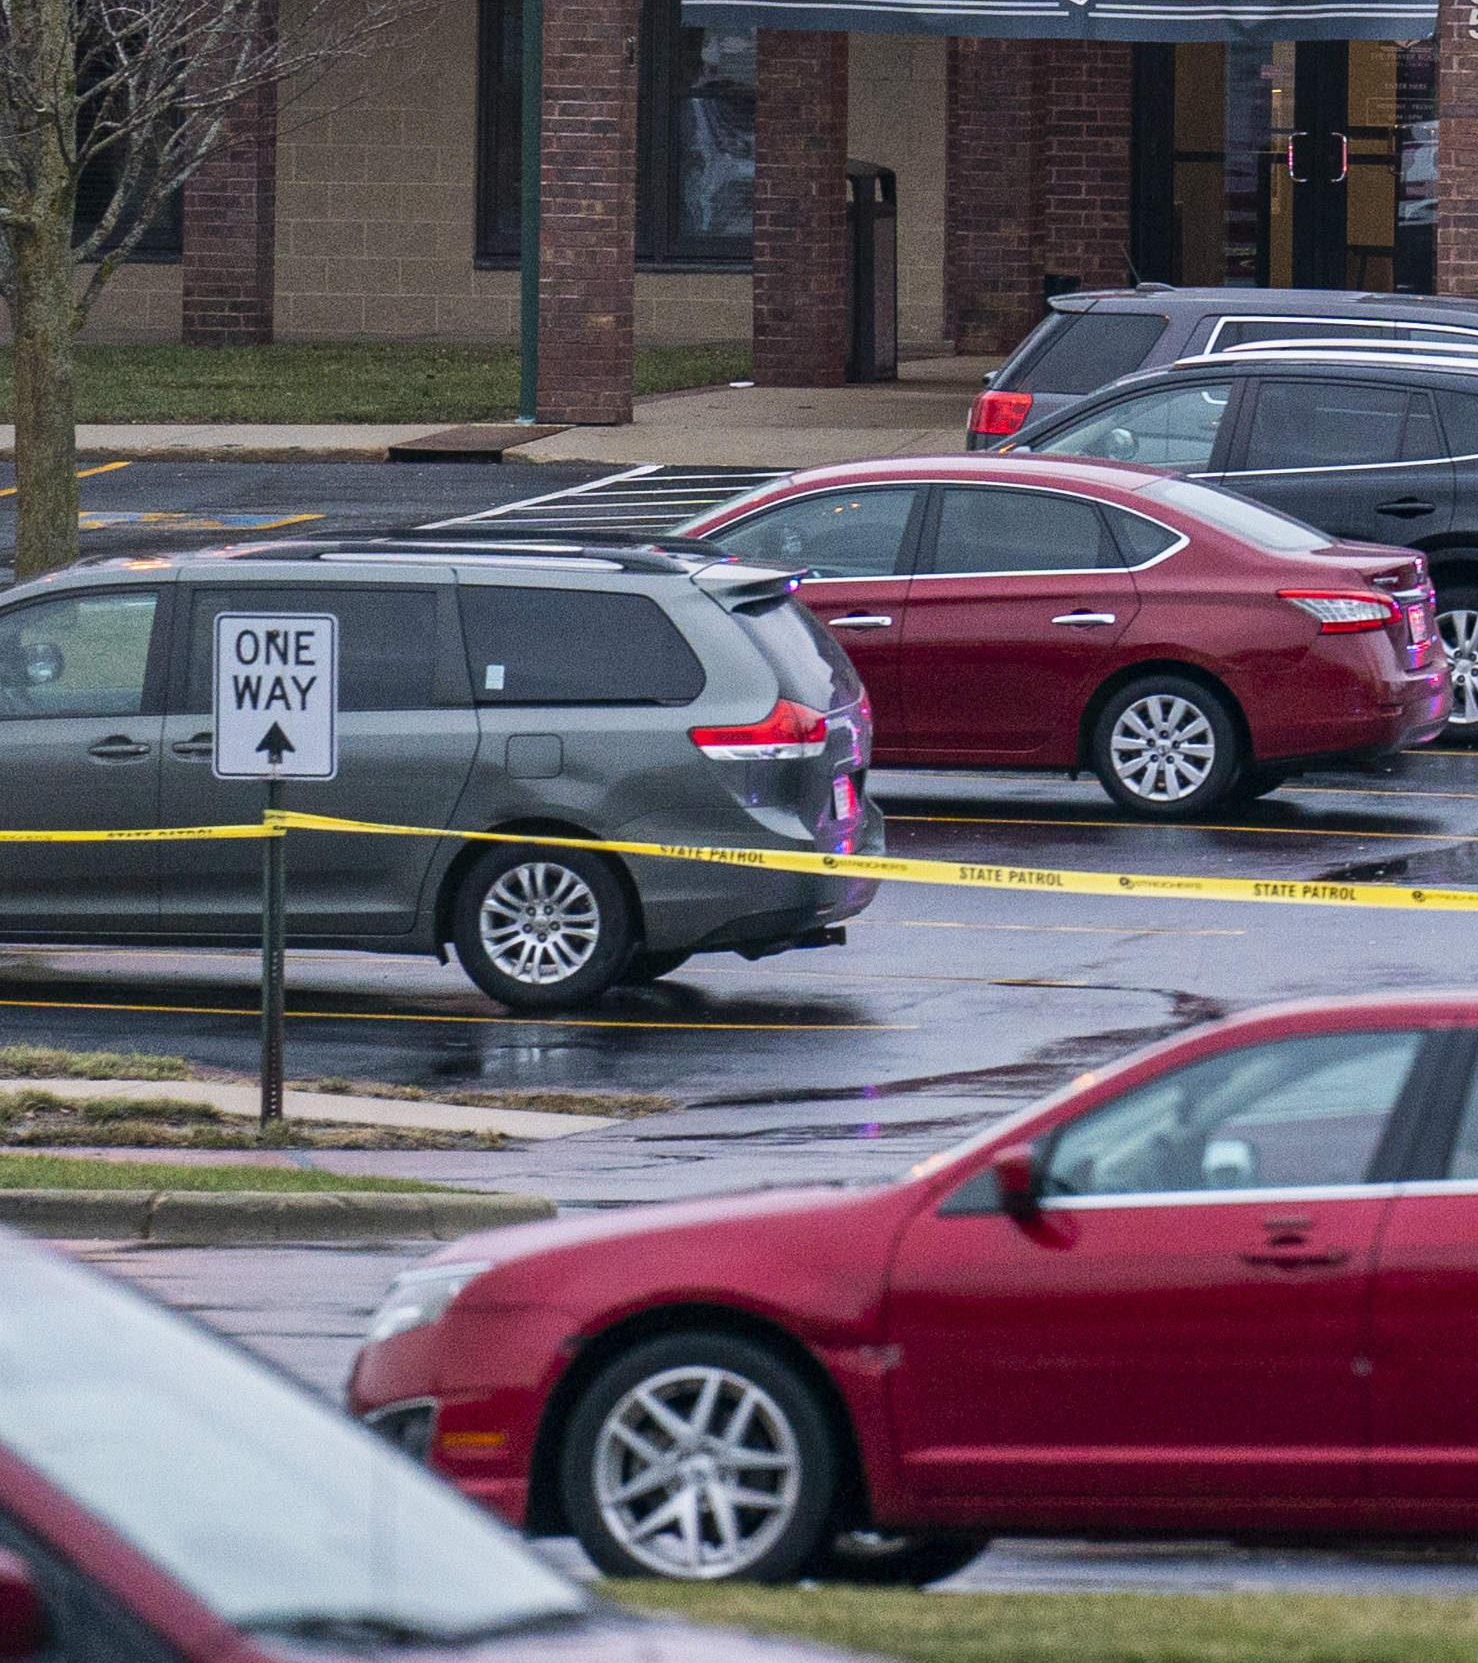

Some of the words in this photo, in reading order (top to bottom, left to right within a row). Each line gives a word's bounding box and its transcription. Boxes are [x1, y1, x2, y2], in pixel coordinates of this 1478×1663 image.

[235, 629, 316, 666] ONE
[232, 675, 317, 711] WAY
[709, 848, 766, 864] PATROL
[959, 866, 1002, 883] STATE
[1008, 870, 1064, 887] PATROL
[1253, 883, 1296, 897] STATE
[1302, 885, 1356, 901] PATROL
